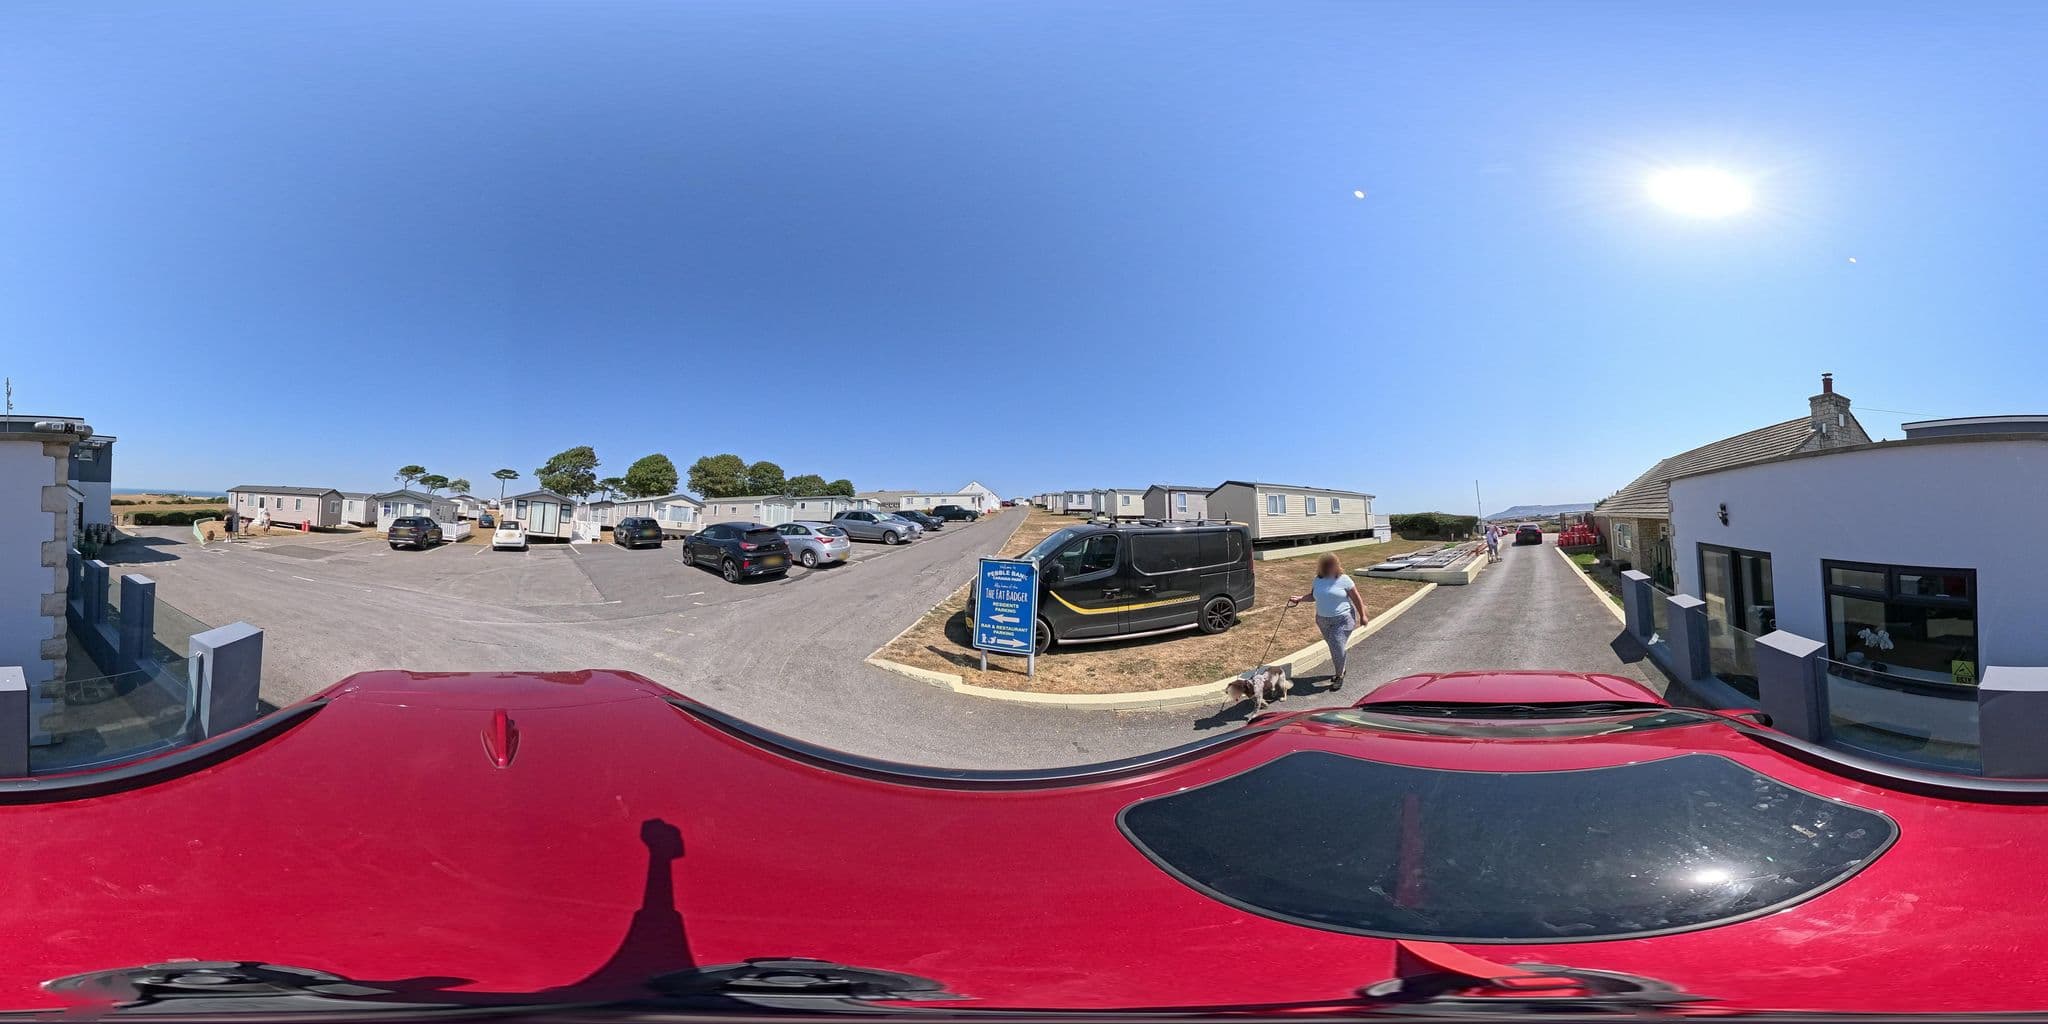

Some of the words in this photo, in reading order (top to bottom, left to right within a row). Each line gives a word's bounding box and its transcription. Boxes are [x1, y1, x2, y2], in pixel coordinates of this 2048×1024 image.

[987, 570, 1010, 578] PEBBLE
[1011, 570, 1028, 580] BANK
[986, 588, 994, 599] THE
[995, 589, 1005, 600] FAT
[1006, 590, 1028, 602] BADGER
